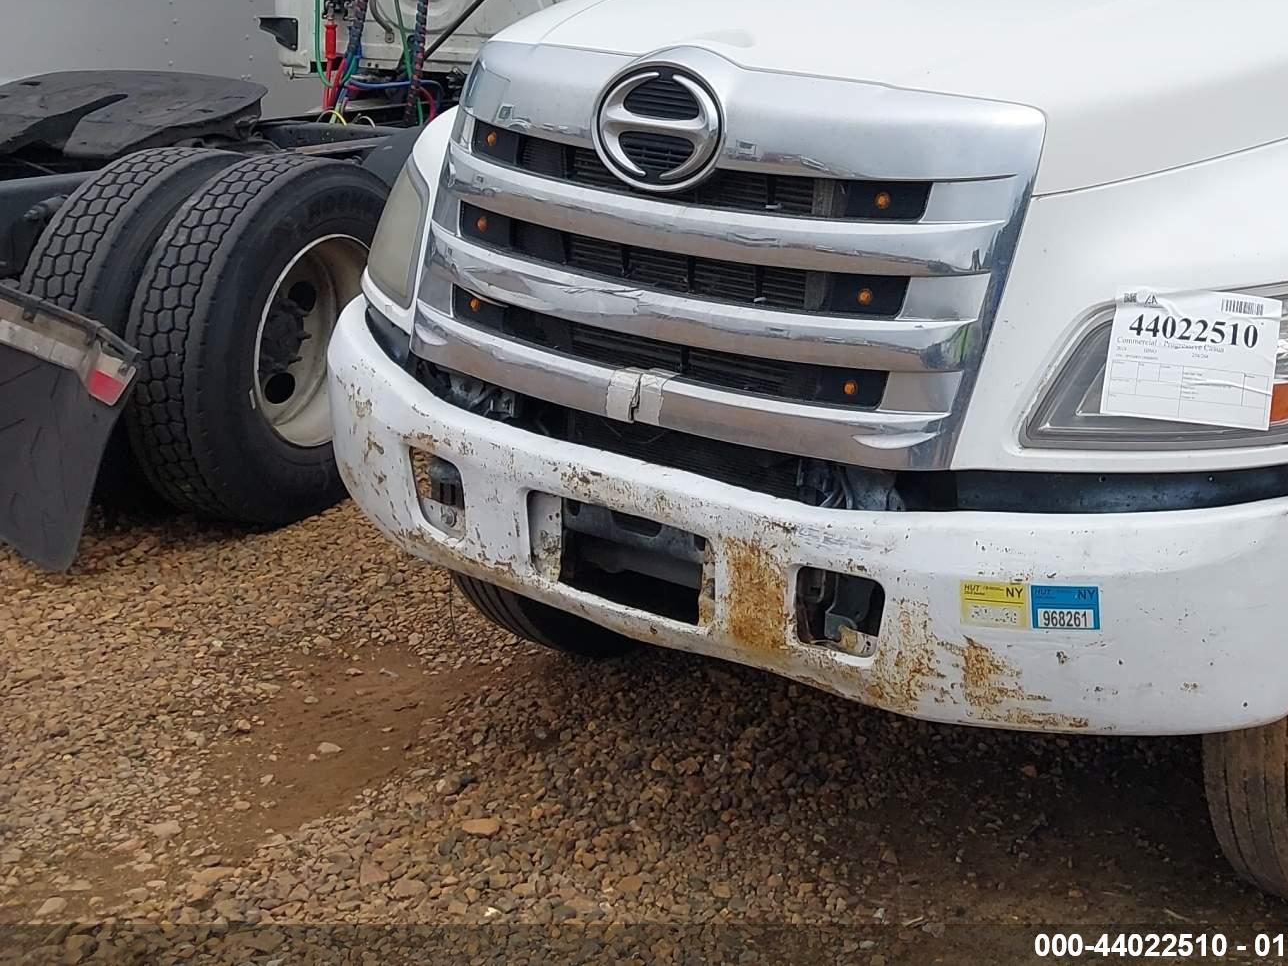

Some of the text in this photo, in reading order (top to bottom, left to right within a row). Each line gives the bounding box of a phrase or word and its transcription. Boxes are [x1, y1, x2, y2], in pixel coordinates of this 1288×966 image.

[1129, 313, 1258, 348] 44022510
[1117, 336, 1158, 346] Commercial
[964, 584, 980, 592] HUT
[1006, 587, 1023, 598] NY
[1078, 589, 1096, 600] NY
[1043, 610, 1087, 627] 968261
